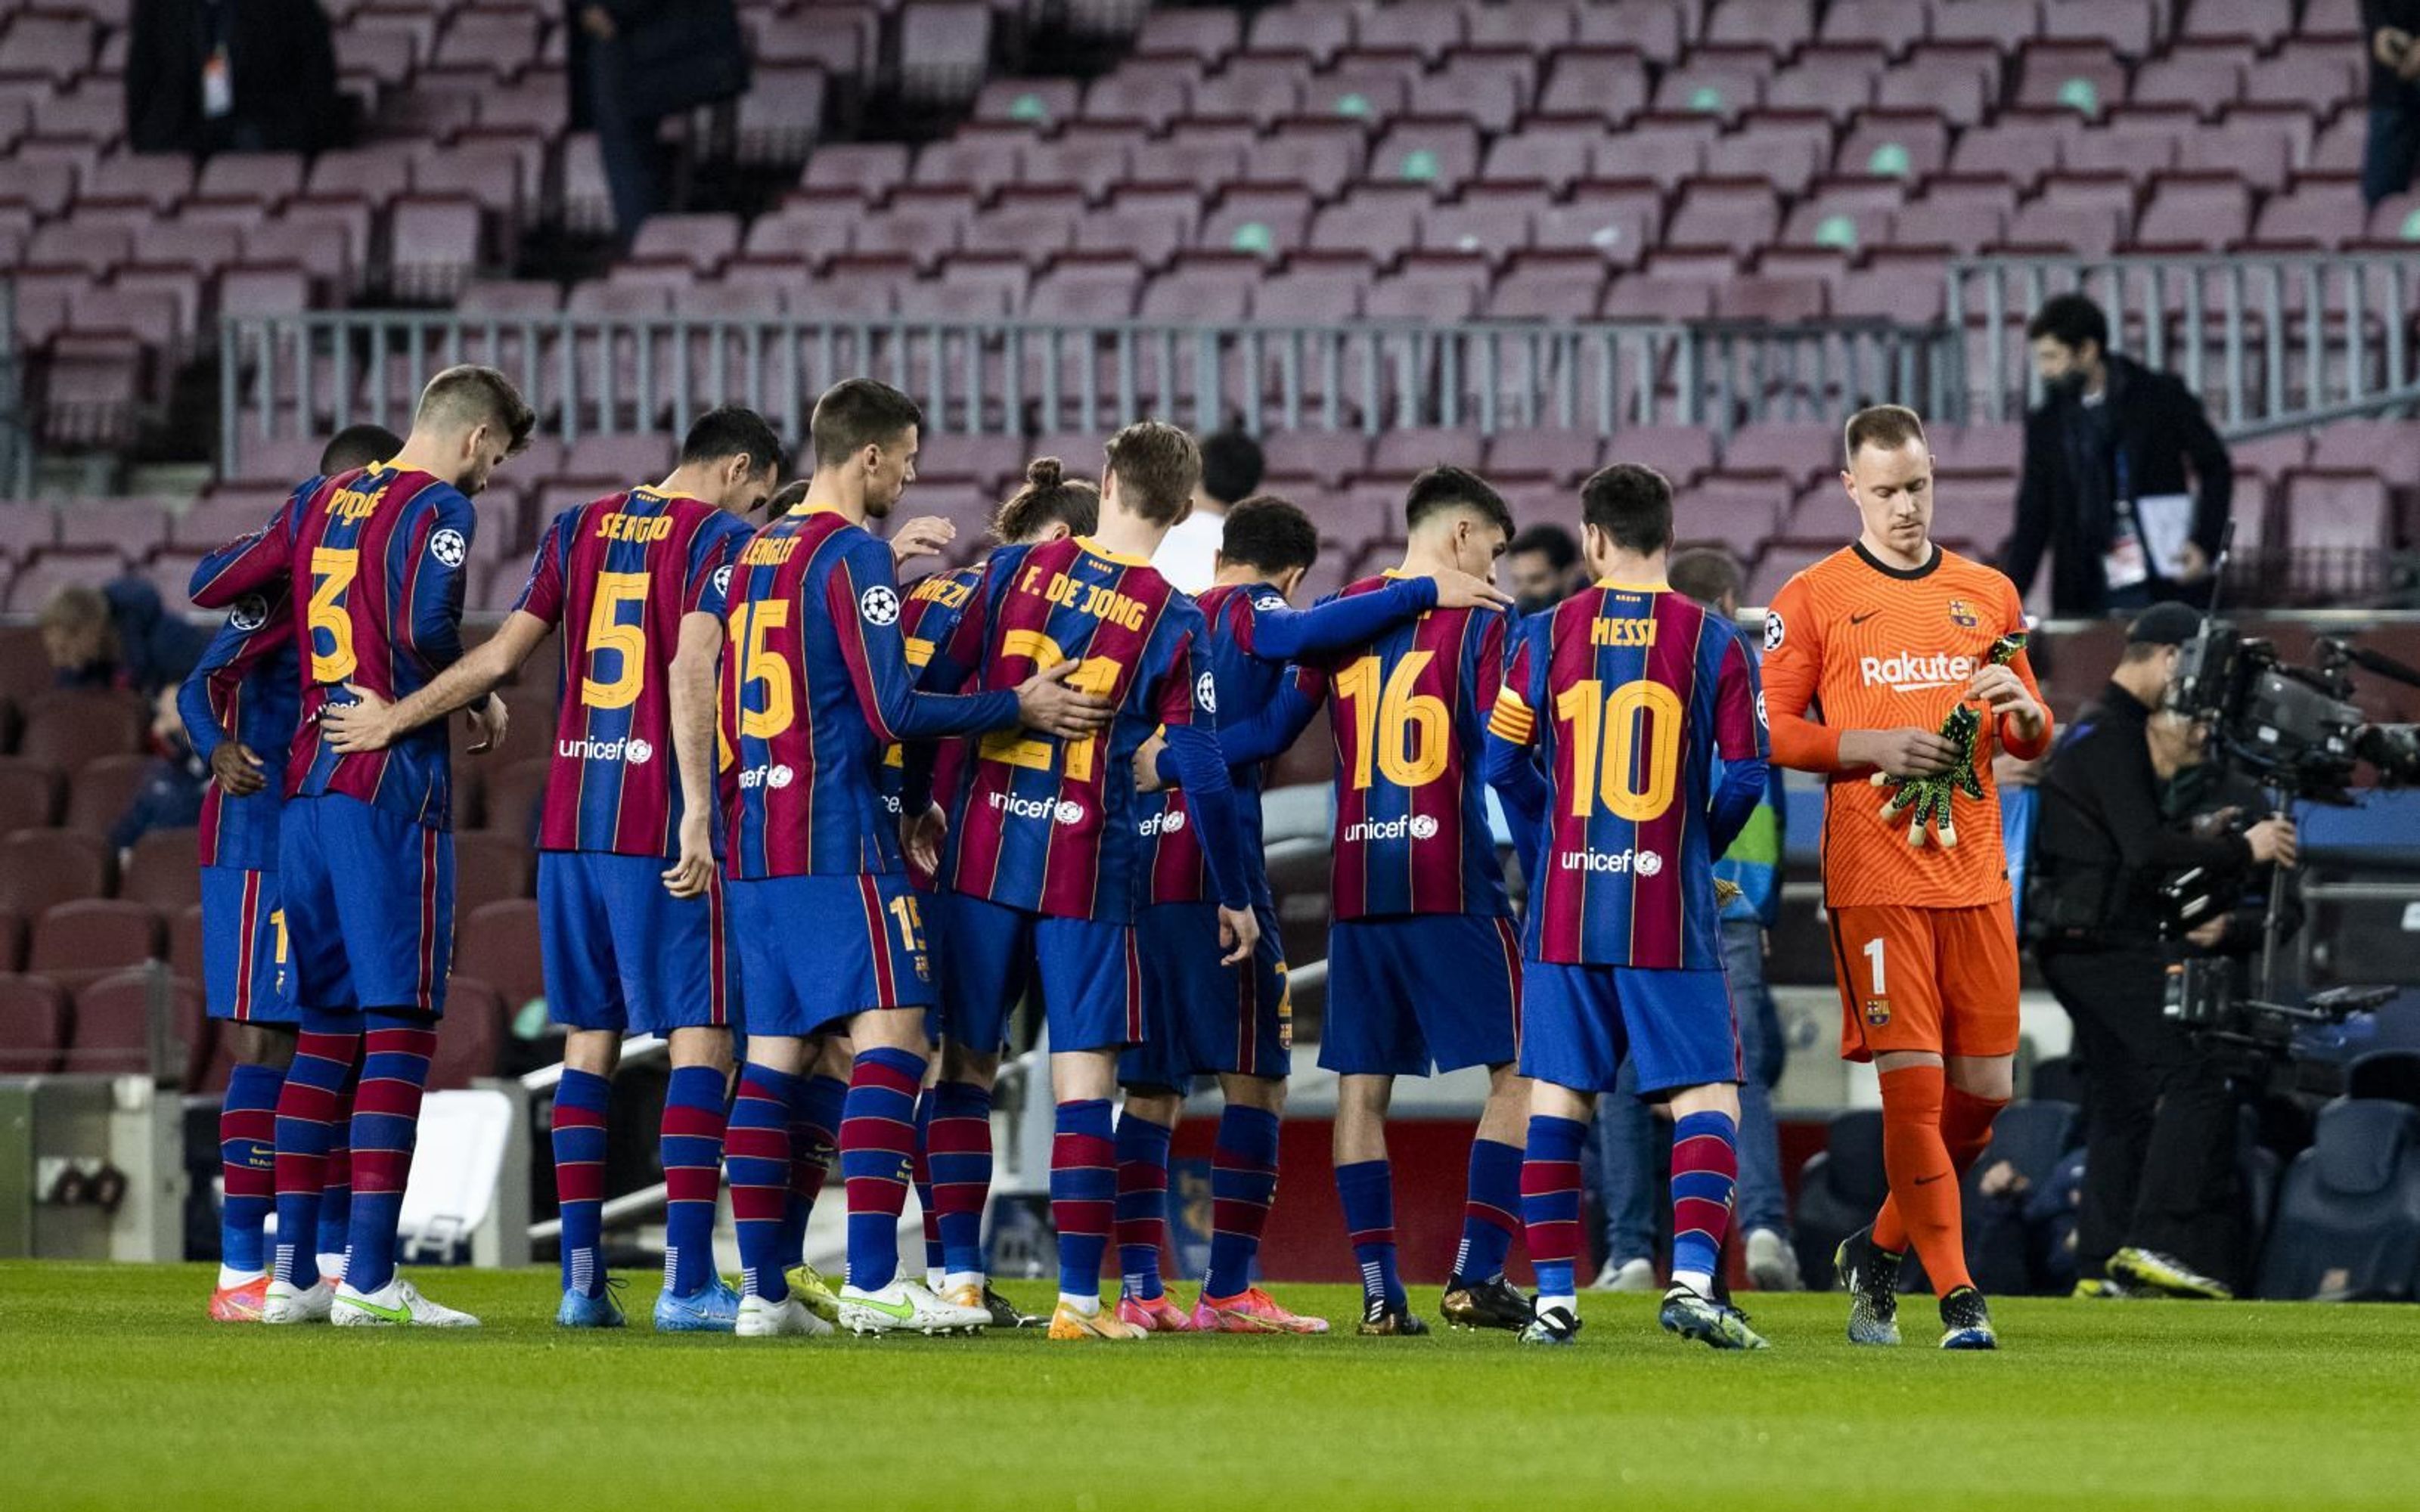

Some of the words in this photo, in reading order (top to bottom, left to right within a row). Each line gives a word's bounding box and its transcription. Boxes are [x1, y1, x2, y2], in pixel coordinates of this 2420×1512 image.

[324, 485, 389, 525] PIQUÉ
[596, 513, 673, 544] SERGIO
[740, 535, 802, 565] LENGLET
[309, 547, 359, 682] 3
[1020, 565, 1042, 596] F.
[1044, 572, 1083, 608] DE
[1079, 584, 1148, 631] JONG
[582, 571, 651, 709] 5
[1590, 617, 1658, 647] MESSI
[728, 599, 795, 739] 15
[1336, 649, 1450, 791] 16
[558, 736, 626, 761] unicef
[1556, 679, 1683, 822] 10
[1345, 814, 1409, 841] unicef
[1562, 847, 1634, 873] unicef
[1863, 937, 1886, 995] 1
